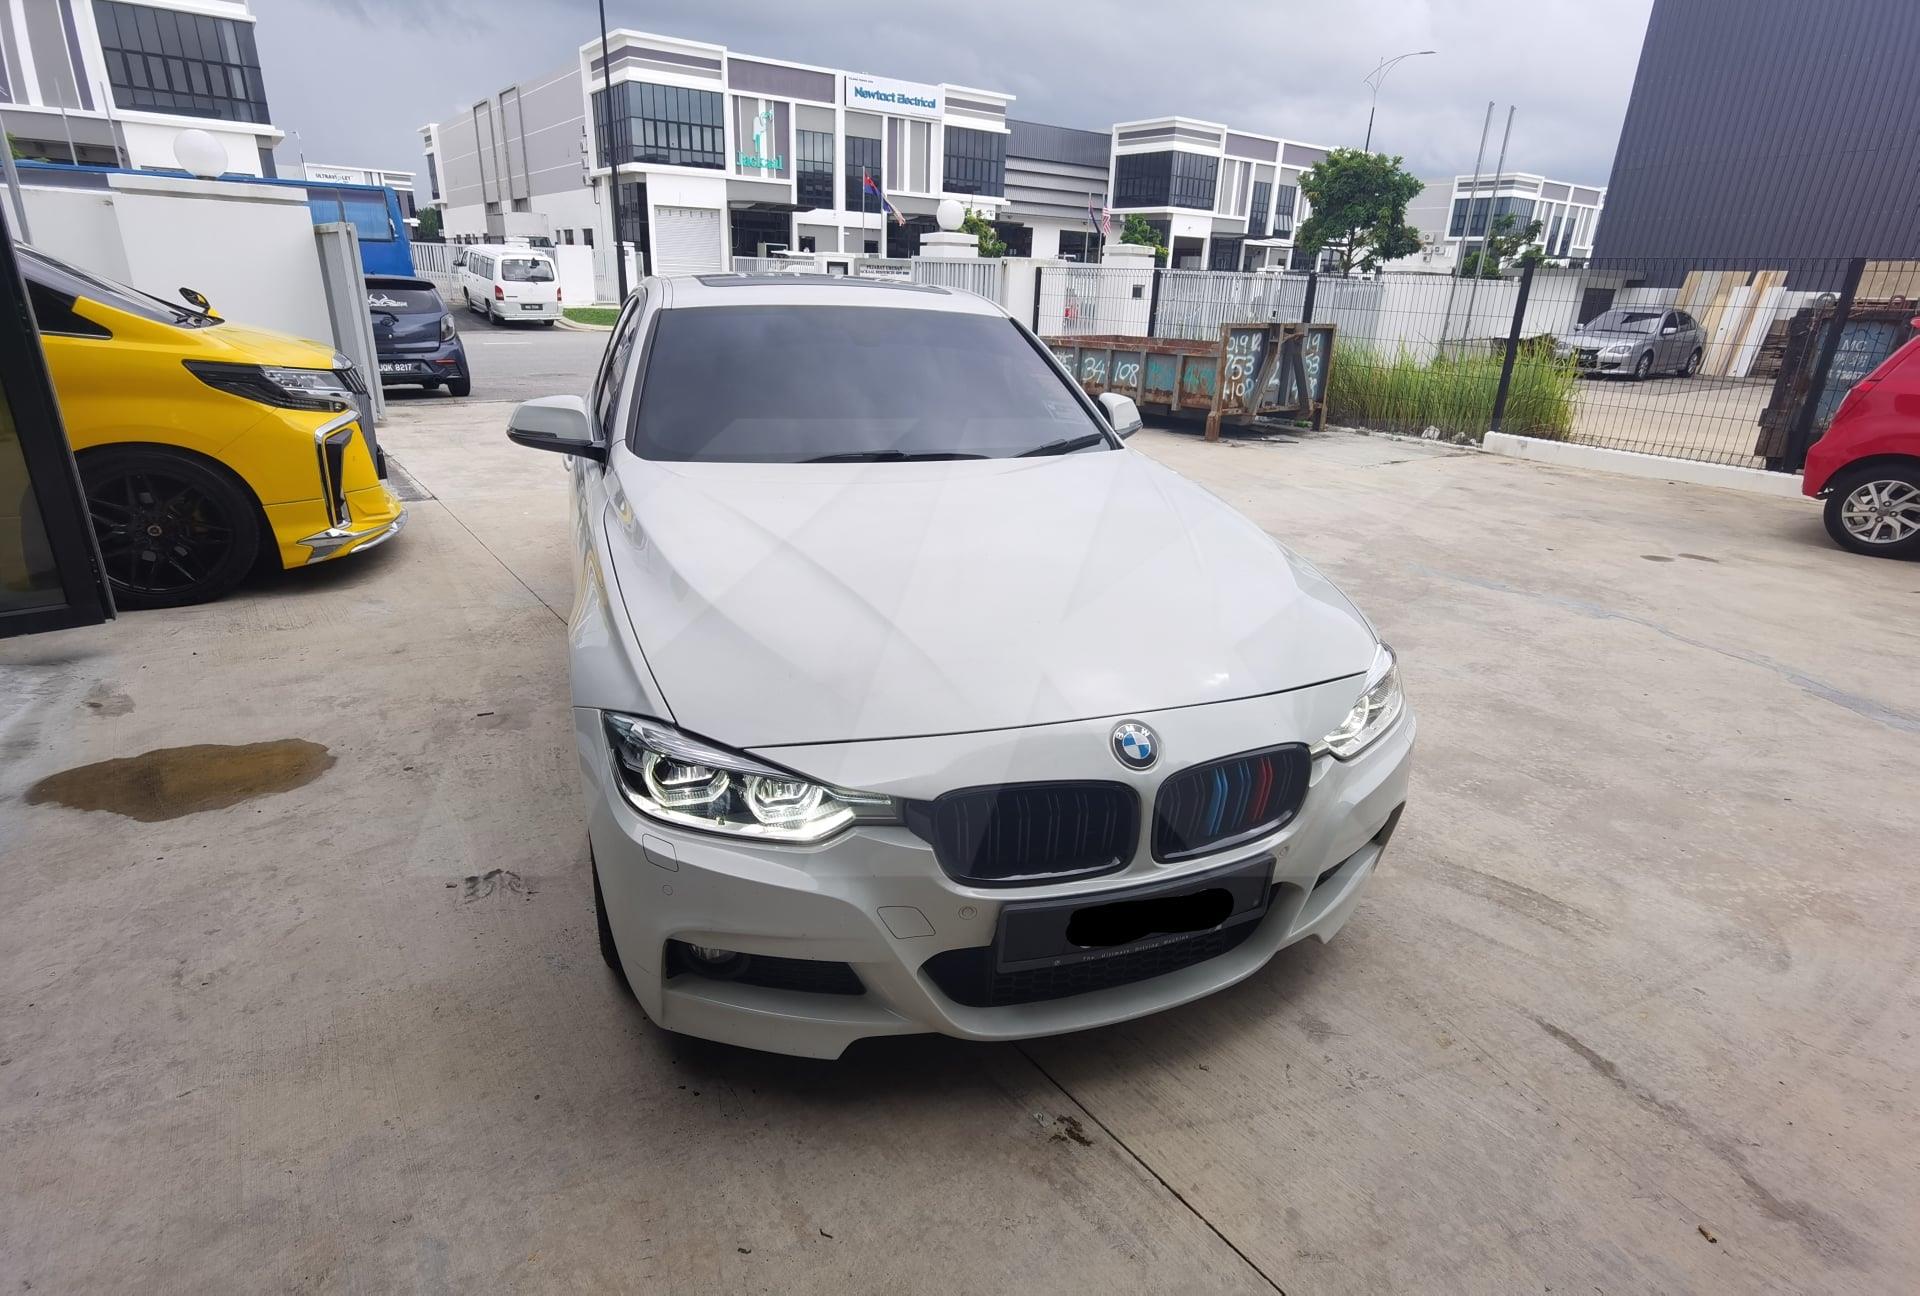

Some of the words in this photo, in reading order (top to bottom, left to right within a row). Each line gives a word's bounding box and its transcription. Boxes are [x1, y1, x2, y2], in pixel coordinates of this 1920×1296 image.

[854, 86, 896, 103] Newtact
[897, 93, 936, 109] Electrical
[395, 363, 412, 371] 8217
[1114, 361, 1140, 387] 108
[1115, 725, 1151, 740] BMW
